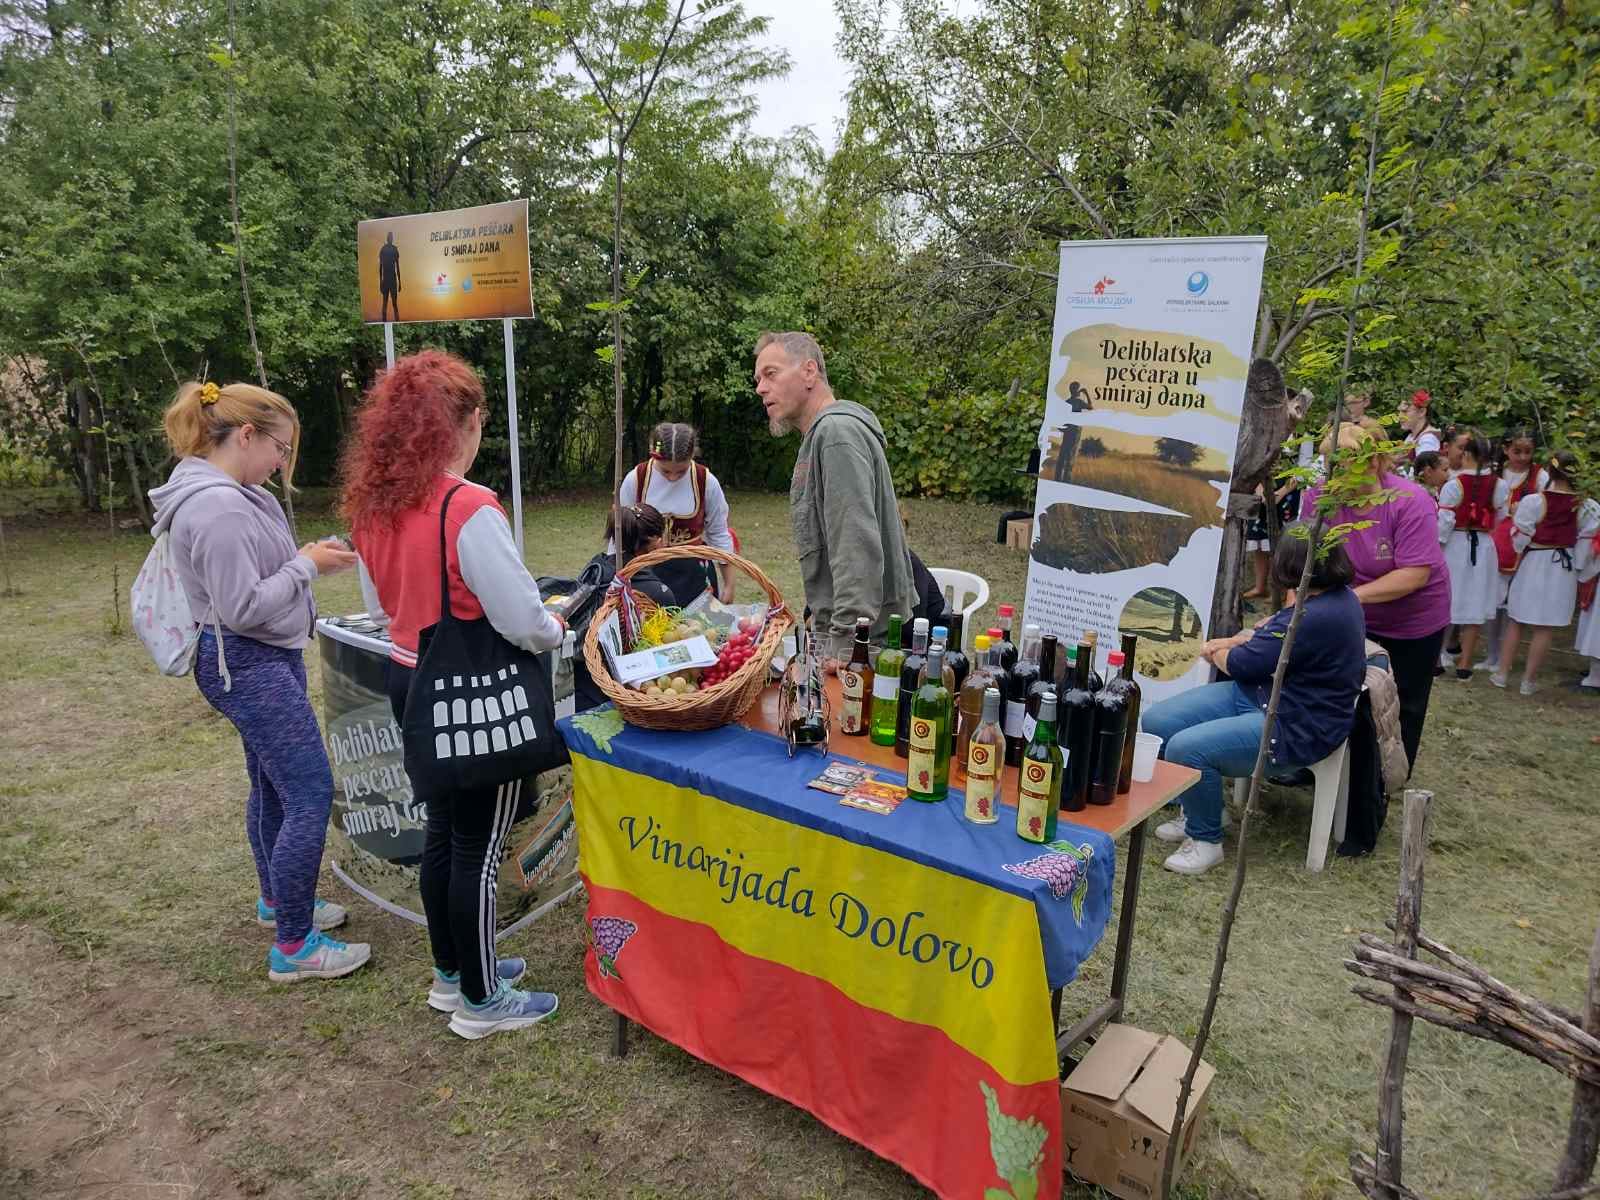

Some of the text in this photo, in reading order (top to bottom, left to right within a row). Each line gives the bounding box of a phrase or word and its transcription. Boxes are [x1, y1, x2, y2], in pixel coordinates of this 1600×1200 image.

[430, 226, 476, 242] DELIBLATSKA
[444, 240, 501, 257] U SMIRAJ DANA
[1099, 339, 1212, 368] Deliblatska
[1105, 363, 1199, 386] peščara u
[1094, 385, 1206, 409] smiraj dana
[329, 719, 403, 766] Deliblat
[343, 760, 402, 810] peščar
[342, 794, 400, 837] smiraj
[619, 816, 816, 917] Vinarijada
[829, 892, 994, 989] Dolovo
